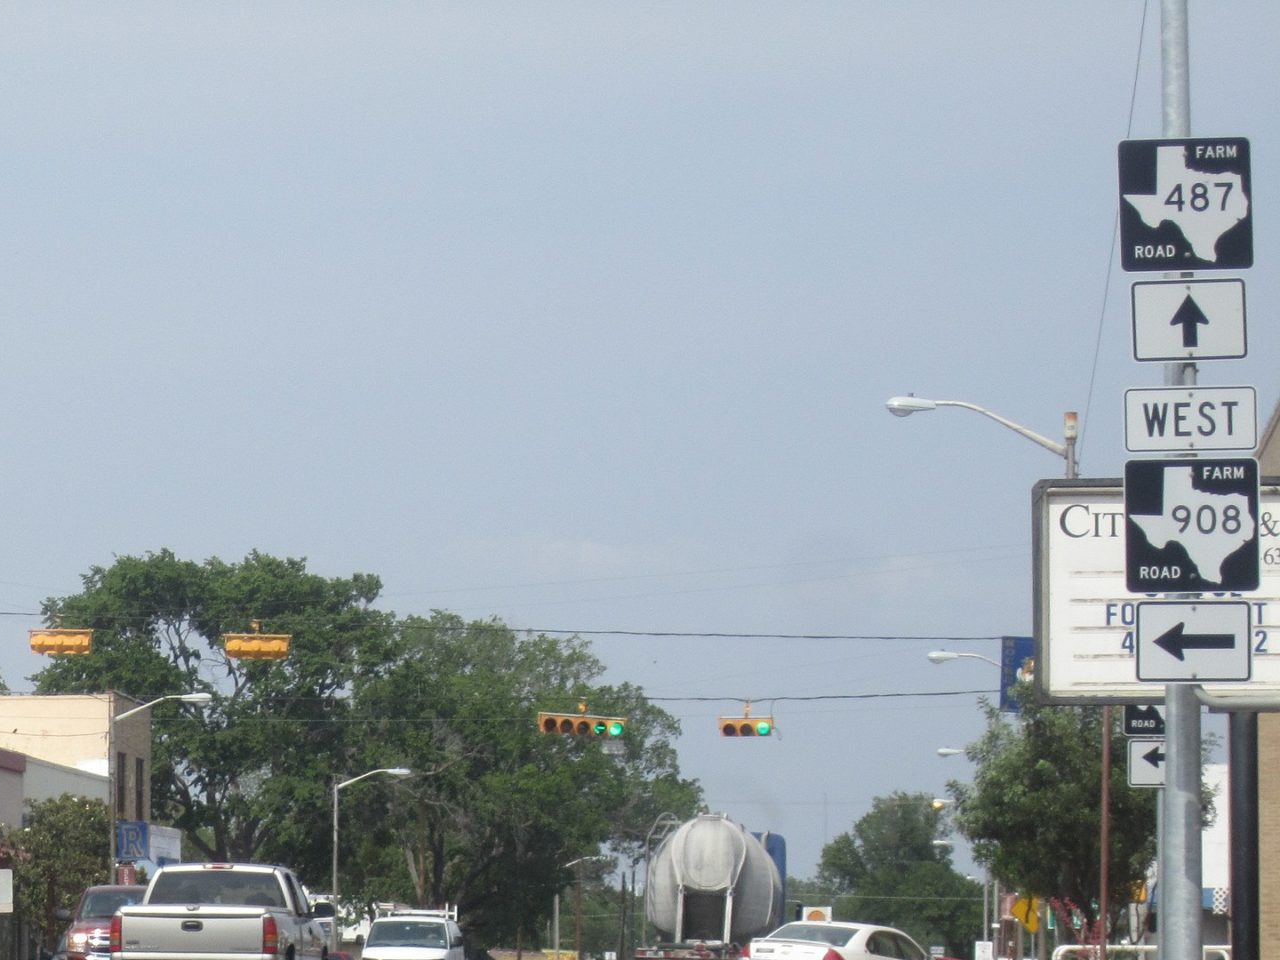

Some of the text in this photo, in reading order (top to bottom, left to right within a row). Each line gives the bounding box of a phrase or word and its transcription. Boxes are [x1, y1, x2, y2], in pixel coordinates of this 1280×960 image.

[1195, 145, 1237, 159] FARM
[1163, 182, 1234, 213] 487
[1134, 245, 1176, 258] ROAD
[1142, 401, 1239, 438] WEST
[1202, 466, 1245, 480] FARM
[1059, 504, 1125, 539] CIT
[1171, 504, 1242, 535] 908
[1139, 566, 1181, 579] ROAD
[1106, 602, 1135, 626] FO
[1130, 719, 1156, 728] ROAD
